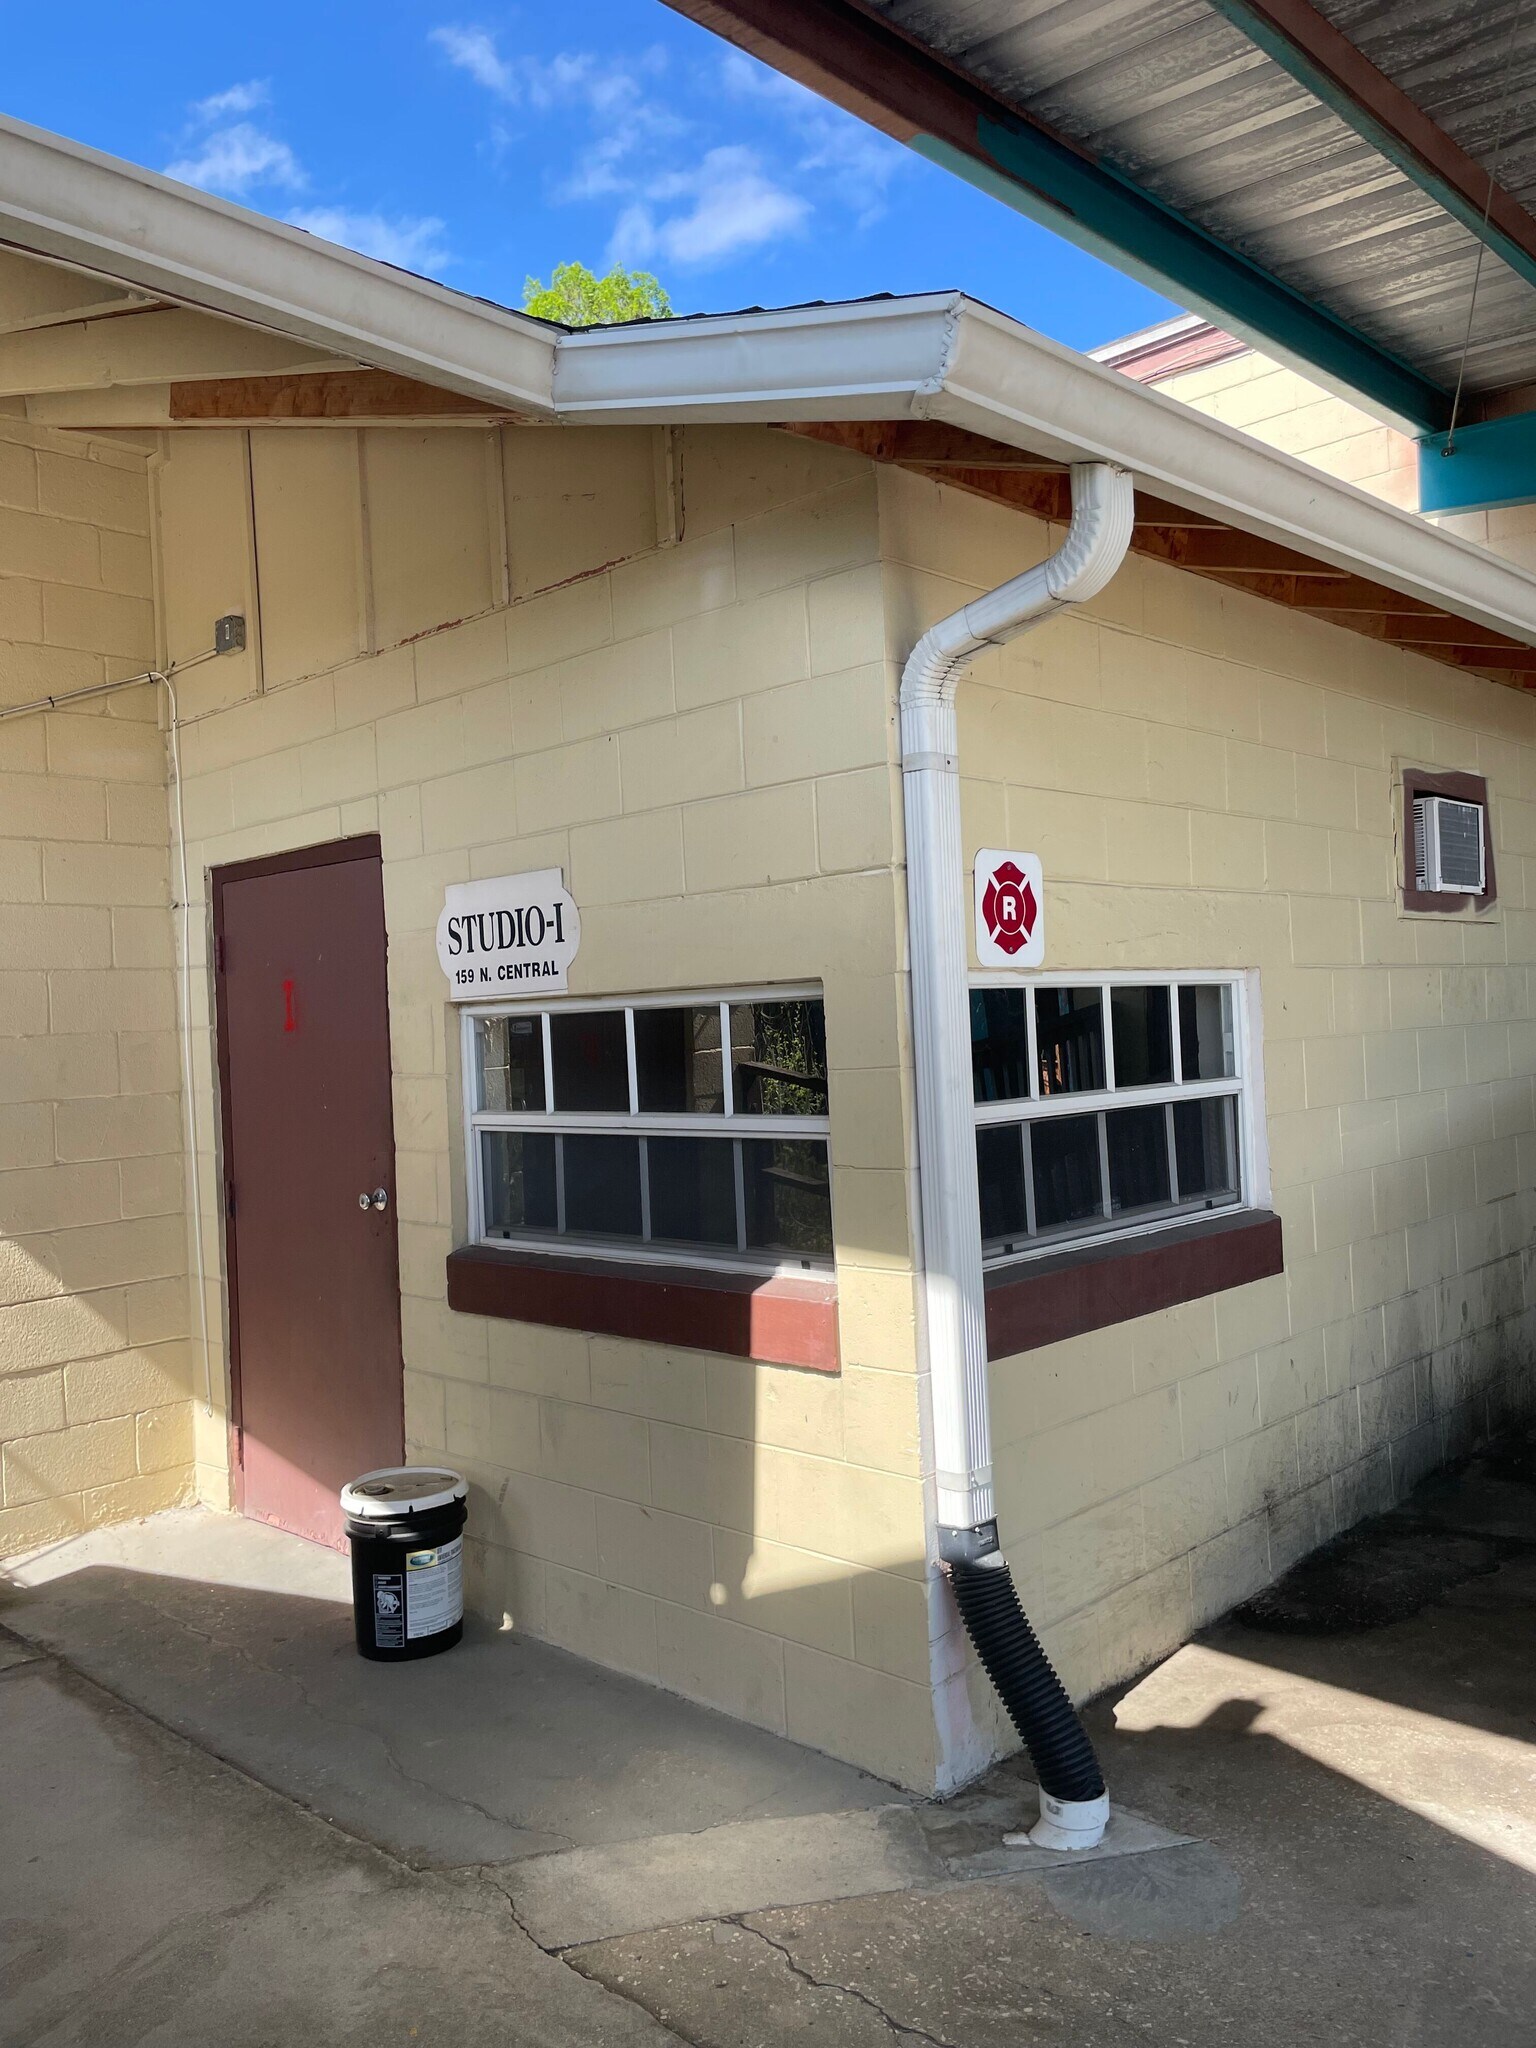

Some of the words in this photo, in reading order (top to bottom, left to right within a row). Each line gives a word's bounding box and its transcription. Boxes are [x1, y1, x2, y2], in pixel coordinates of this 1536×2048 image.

[1002, 895, 1017, 921] R
[448, 902, 565, 955] STUDIO-I
[455, 968, 475, 985] 159
[480, 966, 492, 983] N.
[497, 960, 559, 981] CENTRAL
